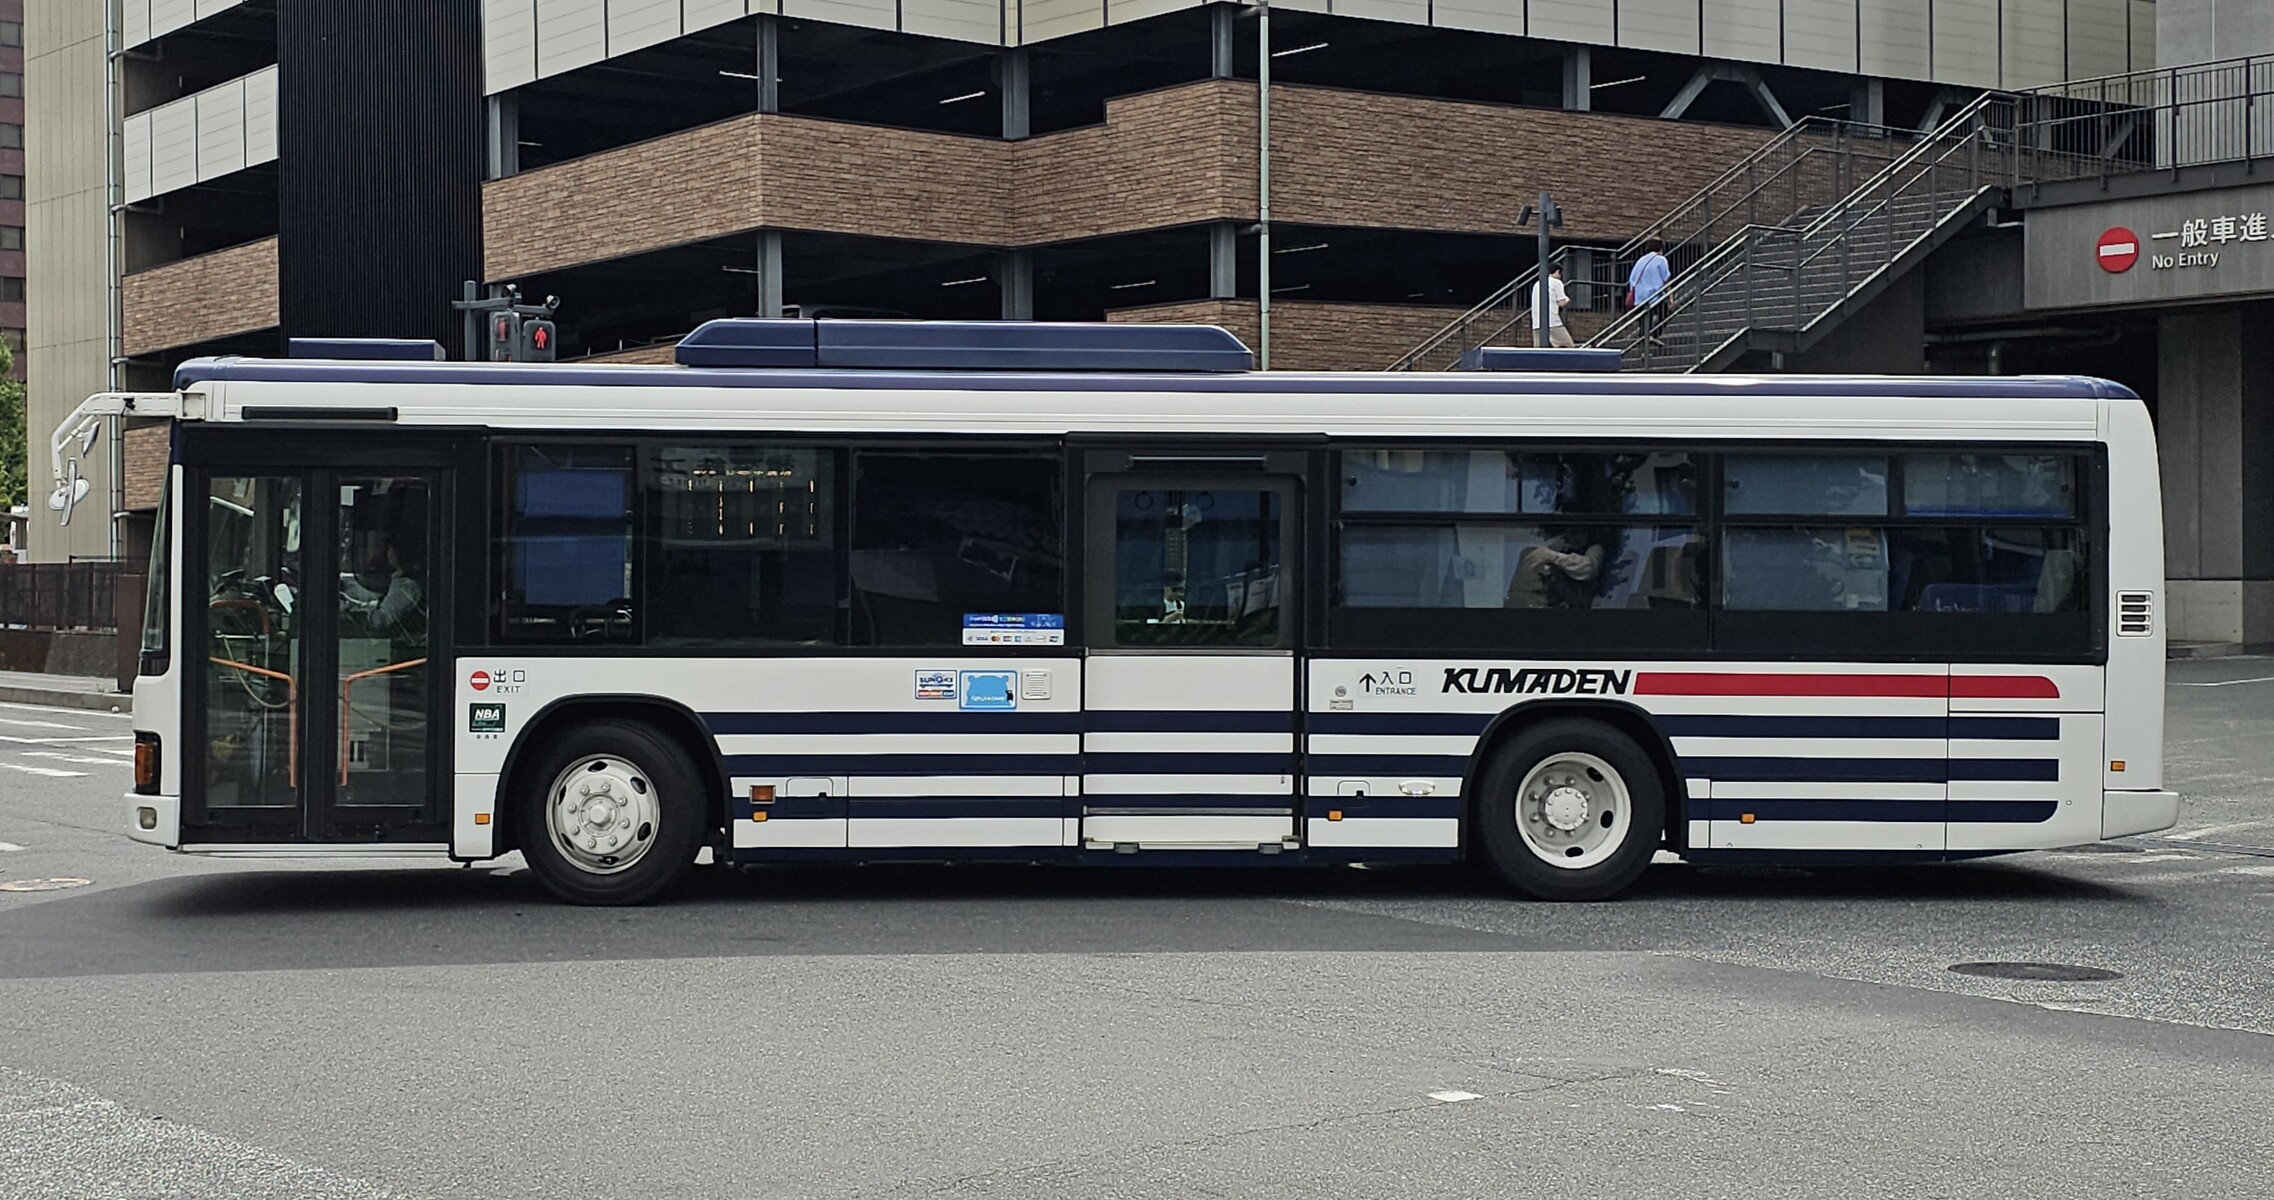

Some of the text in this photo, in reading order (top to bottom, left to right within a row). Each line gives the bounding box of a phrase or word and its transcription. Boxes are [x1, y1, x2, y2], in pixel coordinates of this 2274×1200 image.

[2152, 212, 2274, 248] 一般車進
[2152, 251, 2219, 269] No Entry
[493, 669, 525, 683] 出口
[1380, 671, 1412, 685] 入口
[1442, 667, 1632, 694] KUMADEN
[496, 685, 521, 693] EXIT
[1375, 687, 1416, 695] ENTRANCE
[475, 708, 500, 720] NBA
